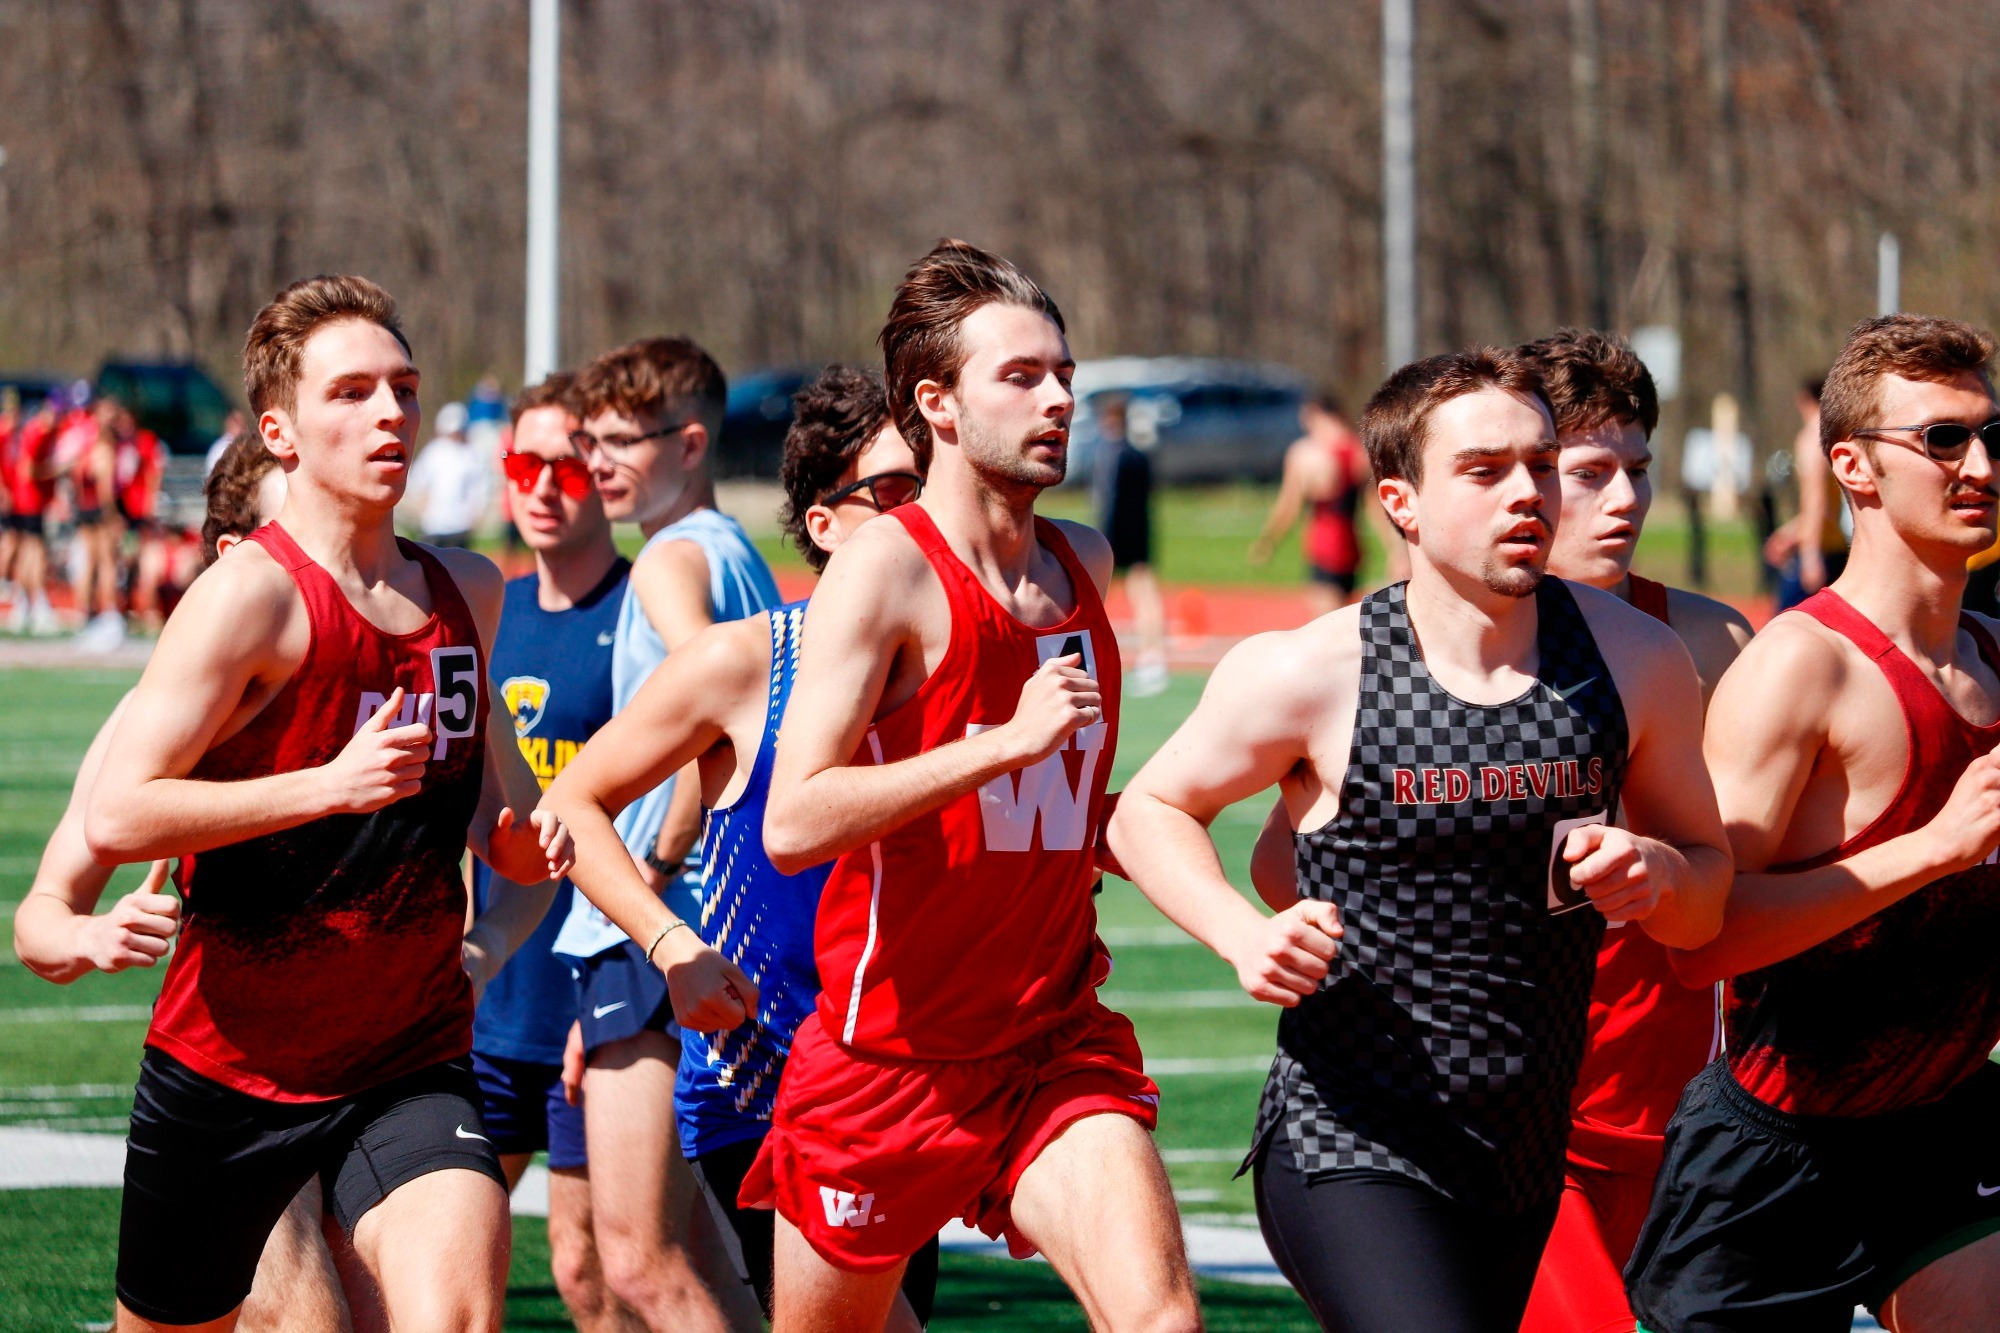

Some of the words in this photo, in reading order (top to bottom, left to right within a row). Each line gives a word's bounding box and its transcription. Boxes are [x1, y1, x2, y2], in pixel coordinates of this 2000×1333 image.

[438, 654, 476, 732] 5
[1392, 768, 1471, 805] RED
[1480, 757, 1603, 802] DEVILS
